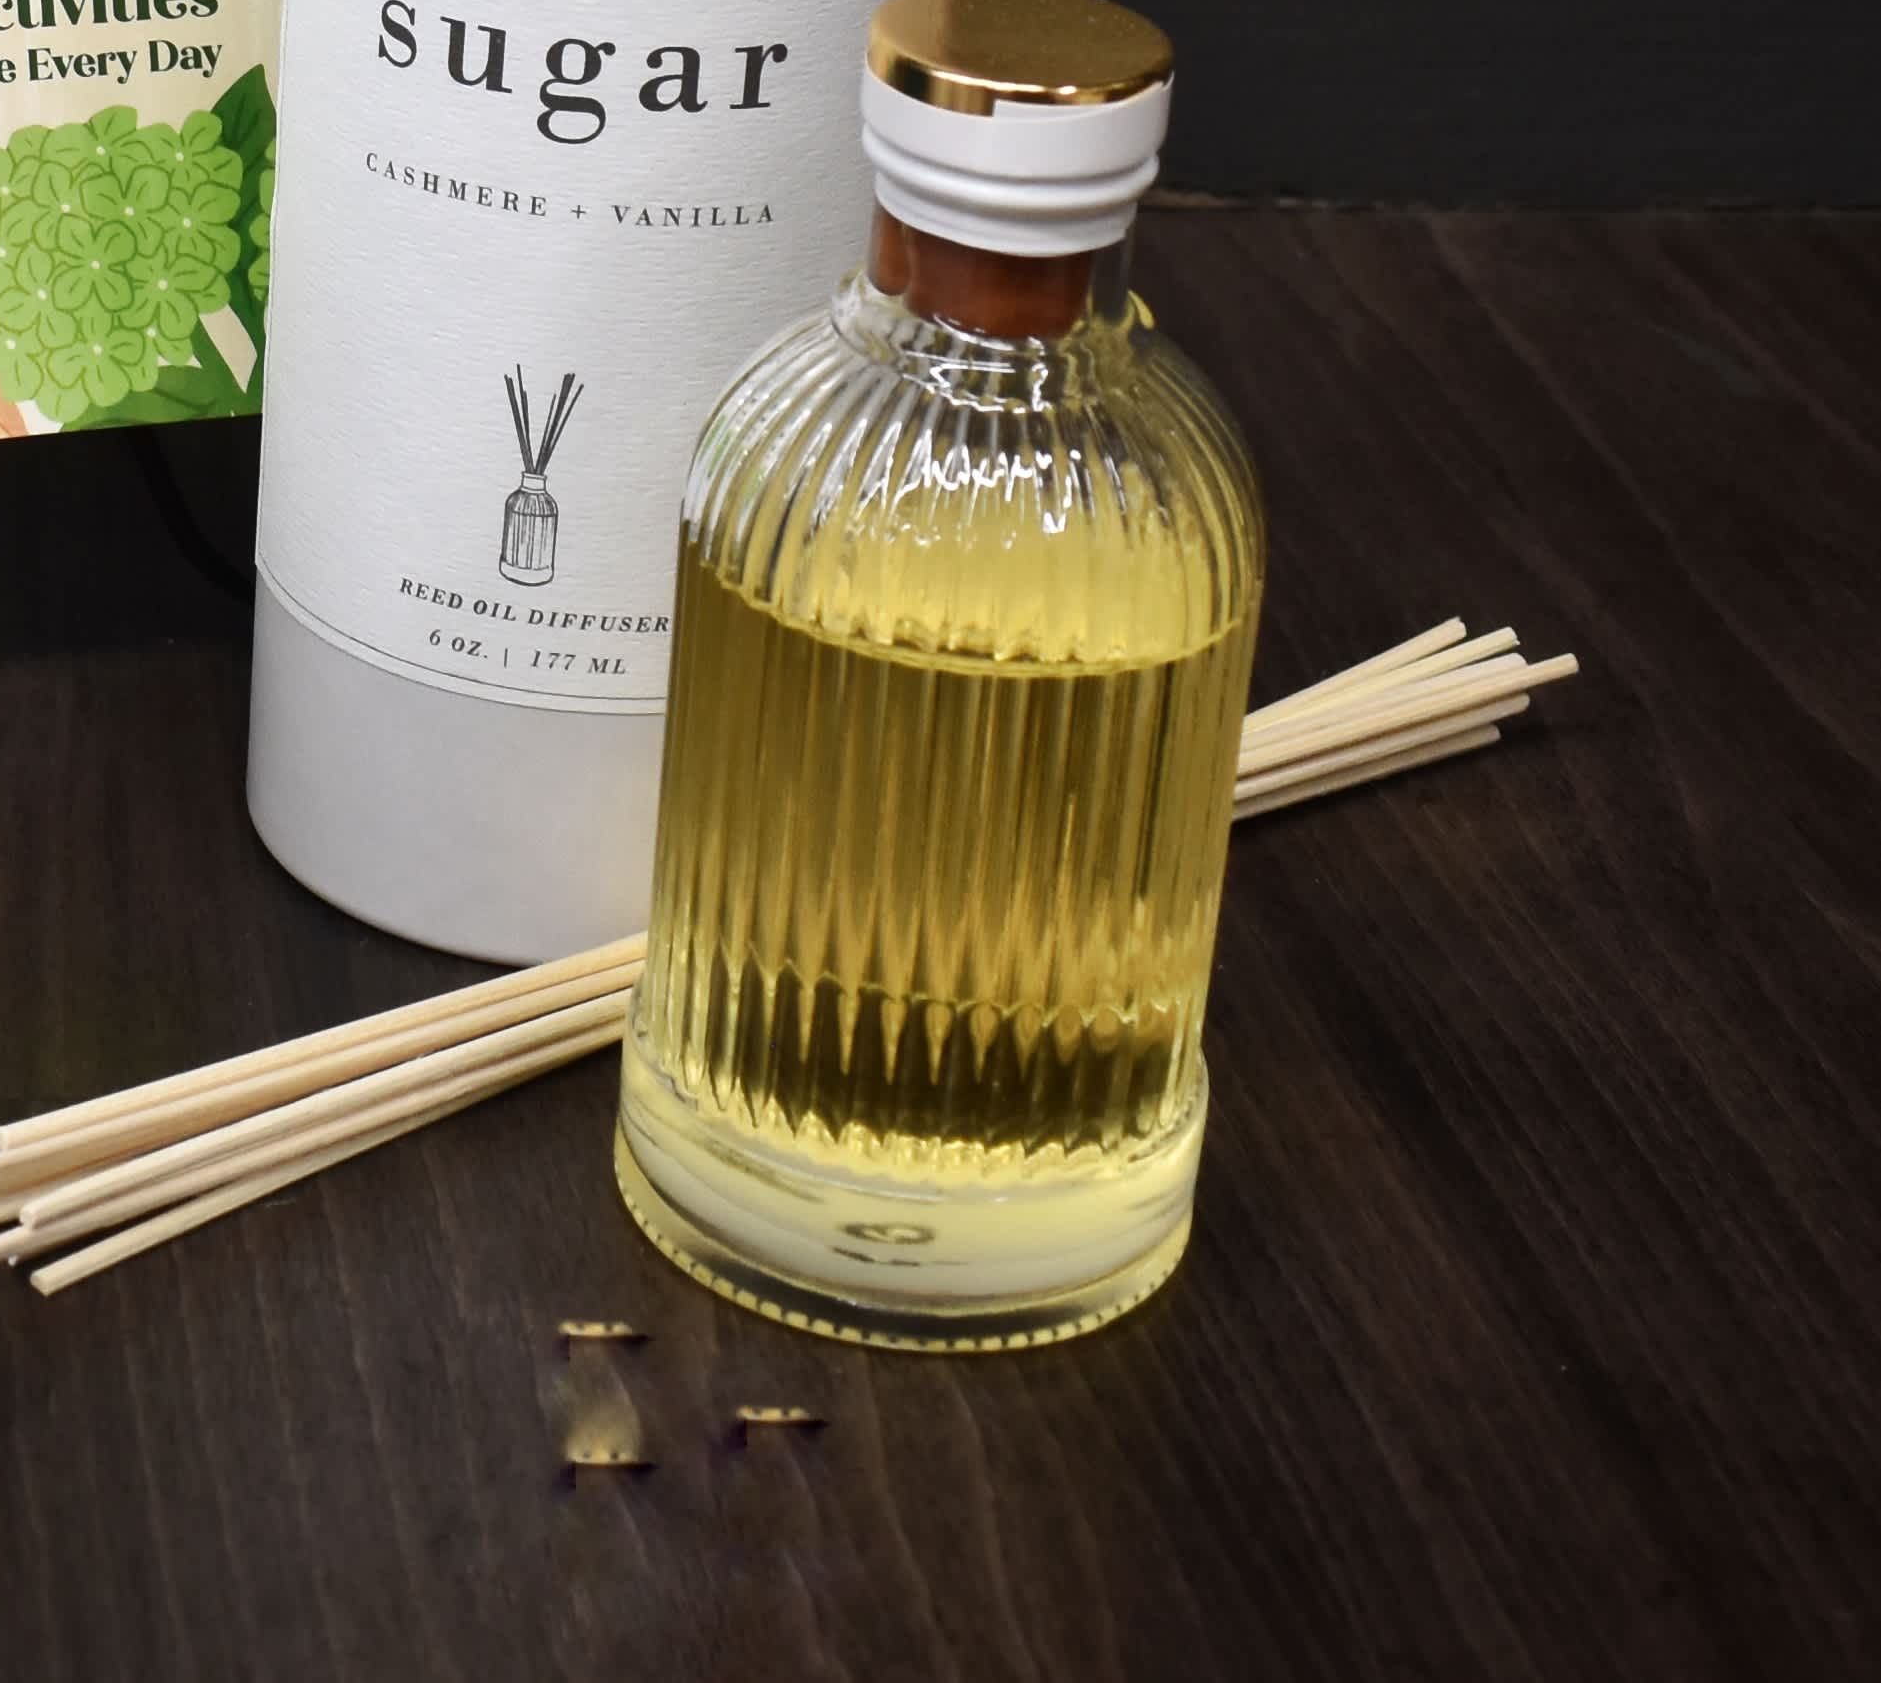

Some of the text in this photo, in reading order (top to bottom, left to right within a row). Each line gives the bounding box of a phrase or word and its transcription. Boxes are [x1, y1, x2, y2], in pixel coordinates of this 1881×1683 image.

[27, 44, 138, 84] Every
[147, 38, 223, 78] Day
[378, 0, 788, 144] sugar
[365, 152, 775, 227] CASHMERE + VANILLA
[399, 578, 670, 633] REED OIL DIFFUSER
[429, 628, 441, 646] 6
[451, 636, 488, 659] OZ.
[530, 649, 576, 671] 177
[587, 657, 627, 675] ML
